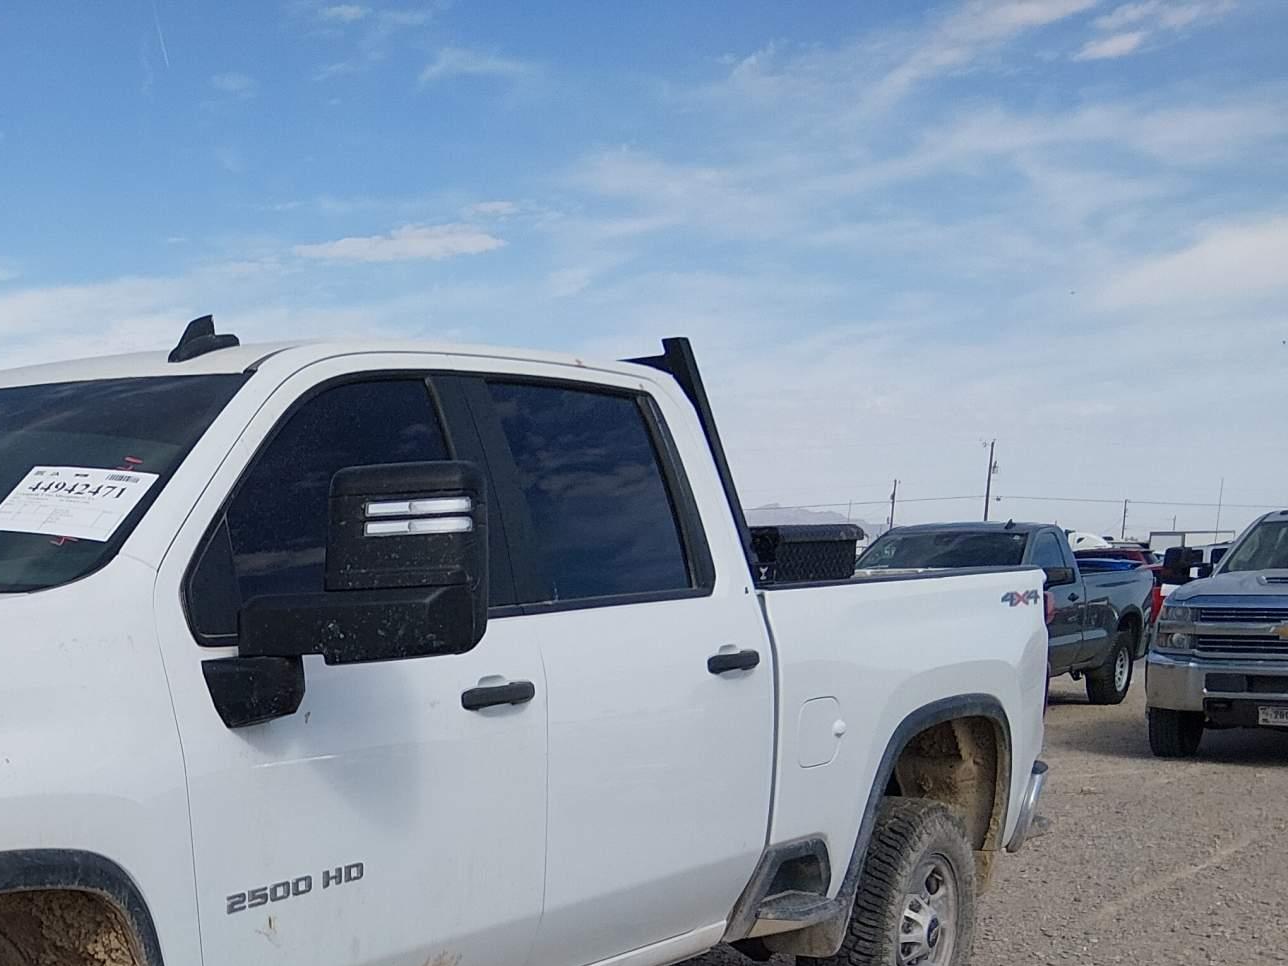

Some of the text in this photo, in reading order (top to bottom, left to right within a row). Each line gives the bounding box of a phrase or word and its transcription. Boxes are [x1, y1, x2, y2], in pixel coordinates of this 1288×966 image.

[28, 480, 127, 499] 44942471
[226, 862, 364, 915] 2500 HD
